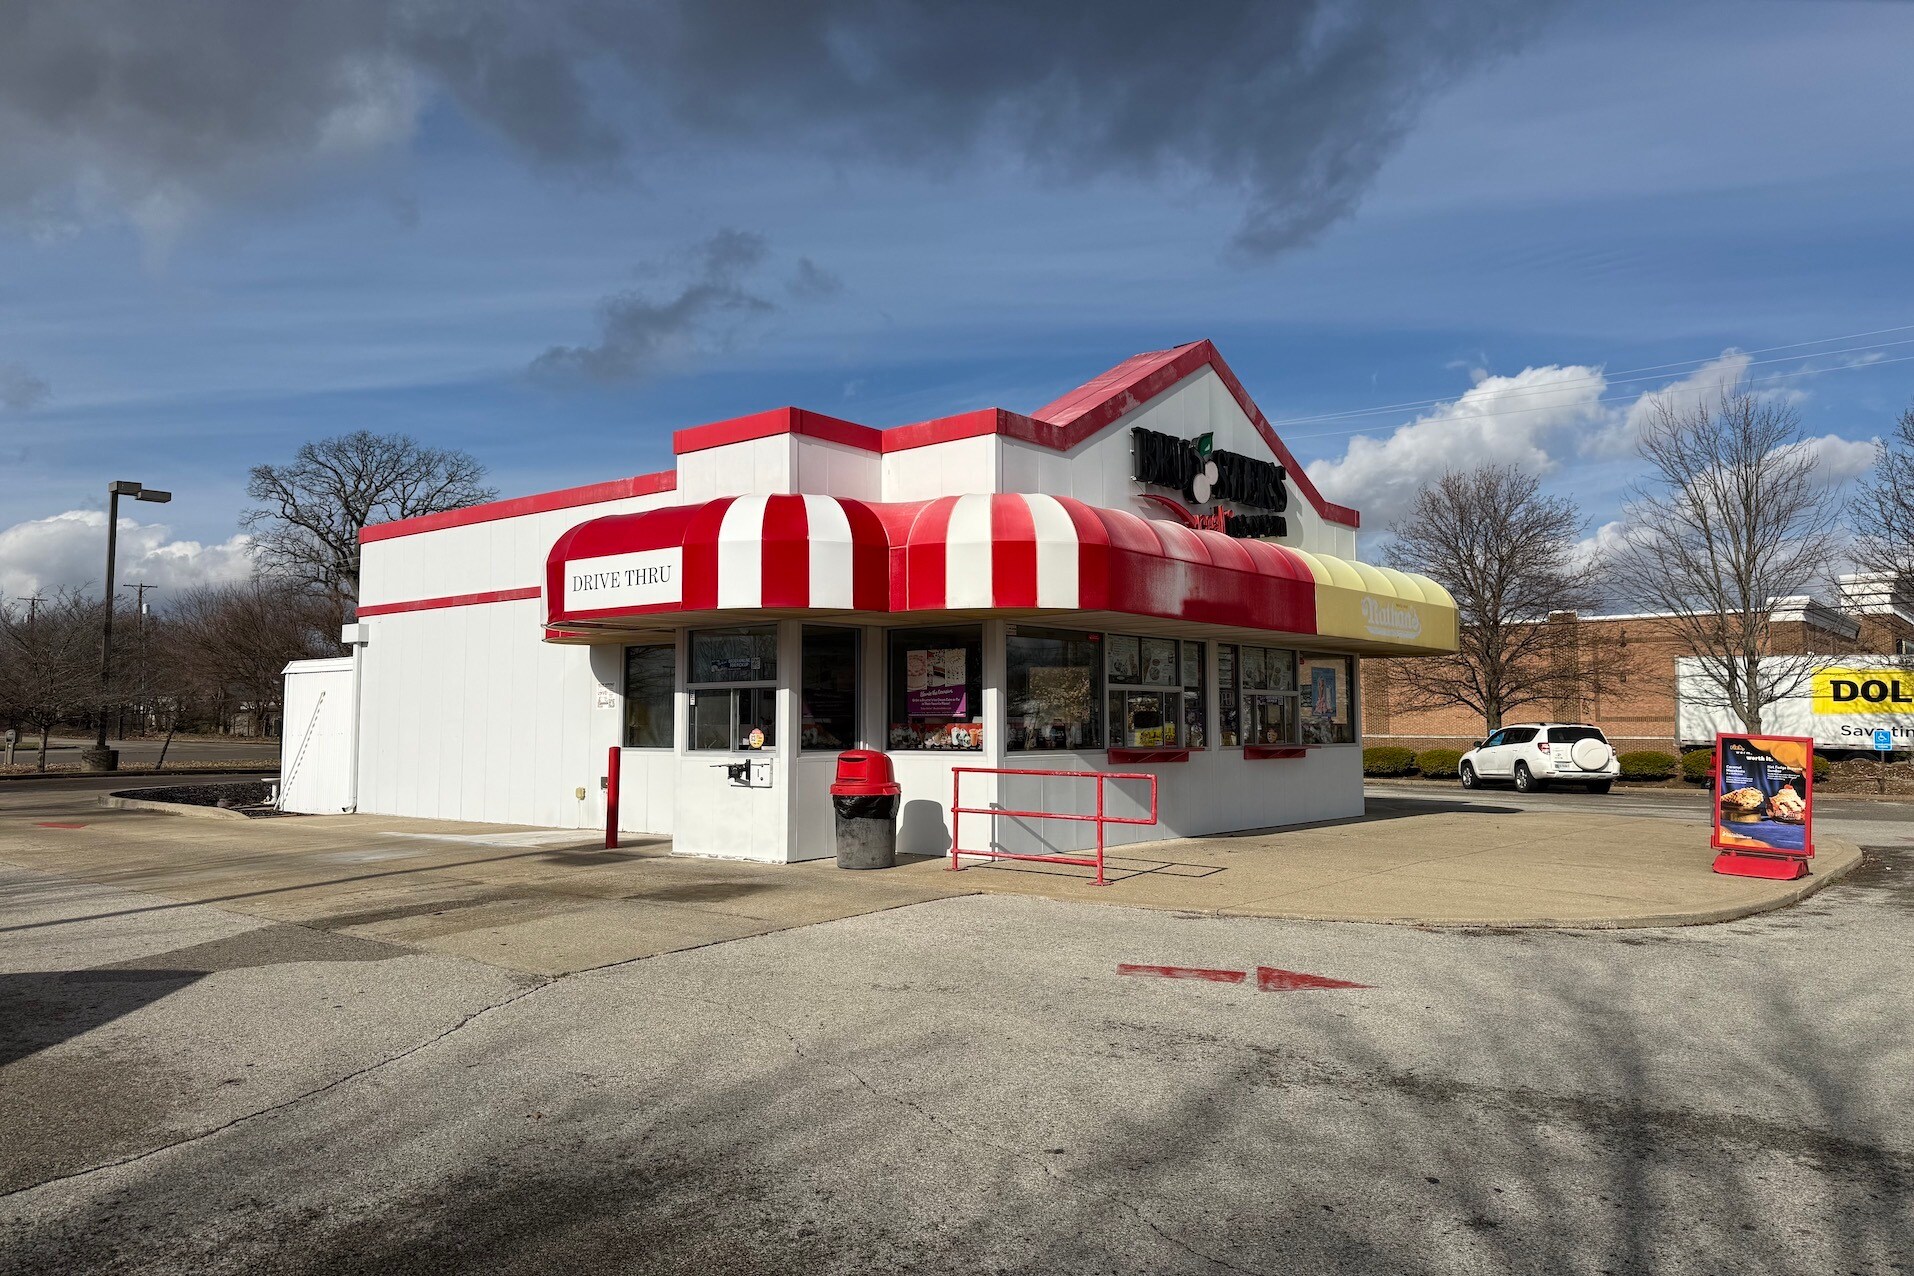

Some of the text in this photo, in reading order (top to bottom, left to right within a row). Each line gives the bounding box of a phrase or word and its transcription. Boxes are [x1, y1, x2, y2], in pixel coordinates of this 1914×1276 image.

[572, 565, 672, 592] DRIVE THRU
[1829, 680, 1913, 703] DOL
